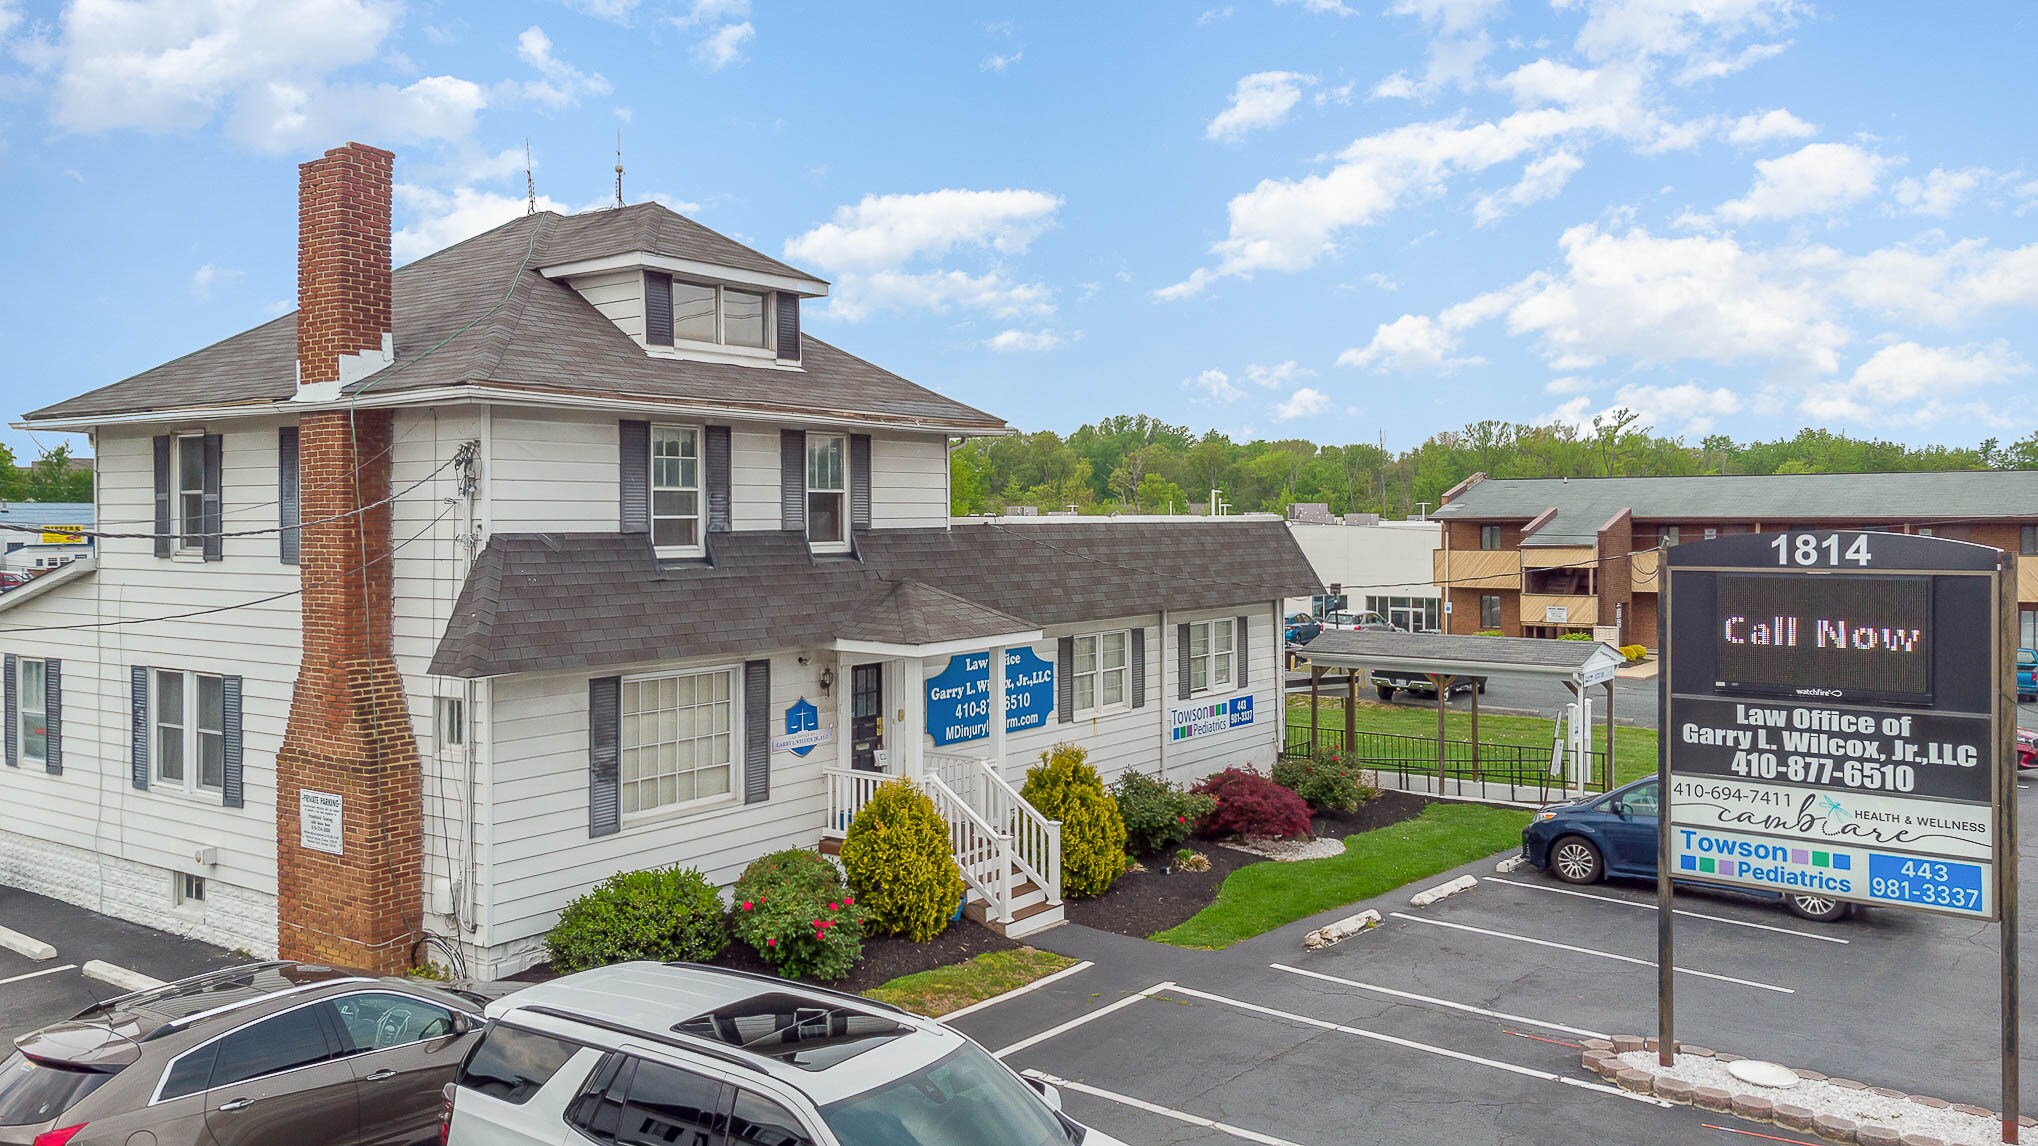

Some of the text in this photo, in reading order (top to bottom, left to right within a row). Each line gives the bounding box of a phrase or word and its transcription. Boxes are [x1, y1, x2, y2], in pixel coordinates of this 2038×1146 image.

[1771, 533, 1872, 566] 1814
[1725, 616, 1921, 652] Call Now
[965, 658, 988, 671] Law
[930, 686, 964, 701] Garry
[966, 682, 976, 695] L.
[1796, 689, 1829, 697] watchfire
[1171, 706, 1209, 725] Towson
[1194, 719, 1226, 736] Pediatrics
[1736, 704, 1912, 737] Law Office of
[1682, 723, 1753, 749] Garry
[1757, 729, 1778, 750] L.
[1782, 730, 1886, 761] Wilcox,
[1731, 751, 1915, 792] 410-877-6510
[1673, 782, 1791, 807] 410-694-7411
[1854, 810, 1986, 833] HEALTH & WELLNESS
[1680, 829, 1788, 862] Towson
[1738, 861, 1851, 893] Pediatrics
[1901, 861, 1949, 882] 443
[1872, 877, 1979, 908] 981-3337
